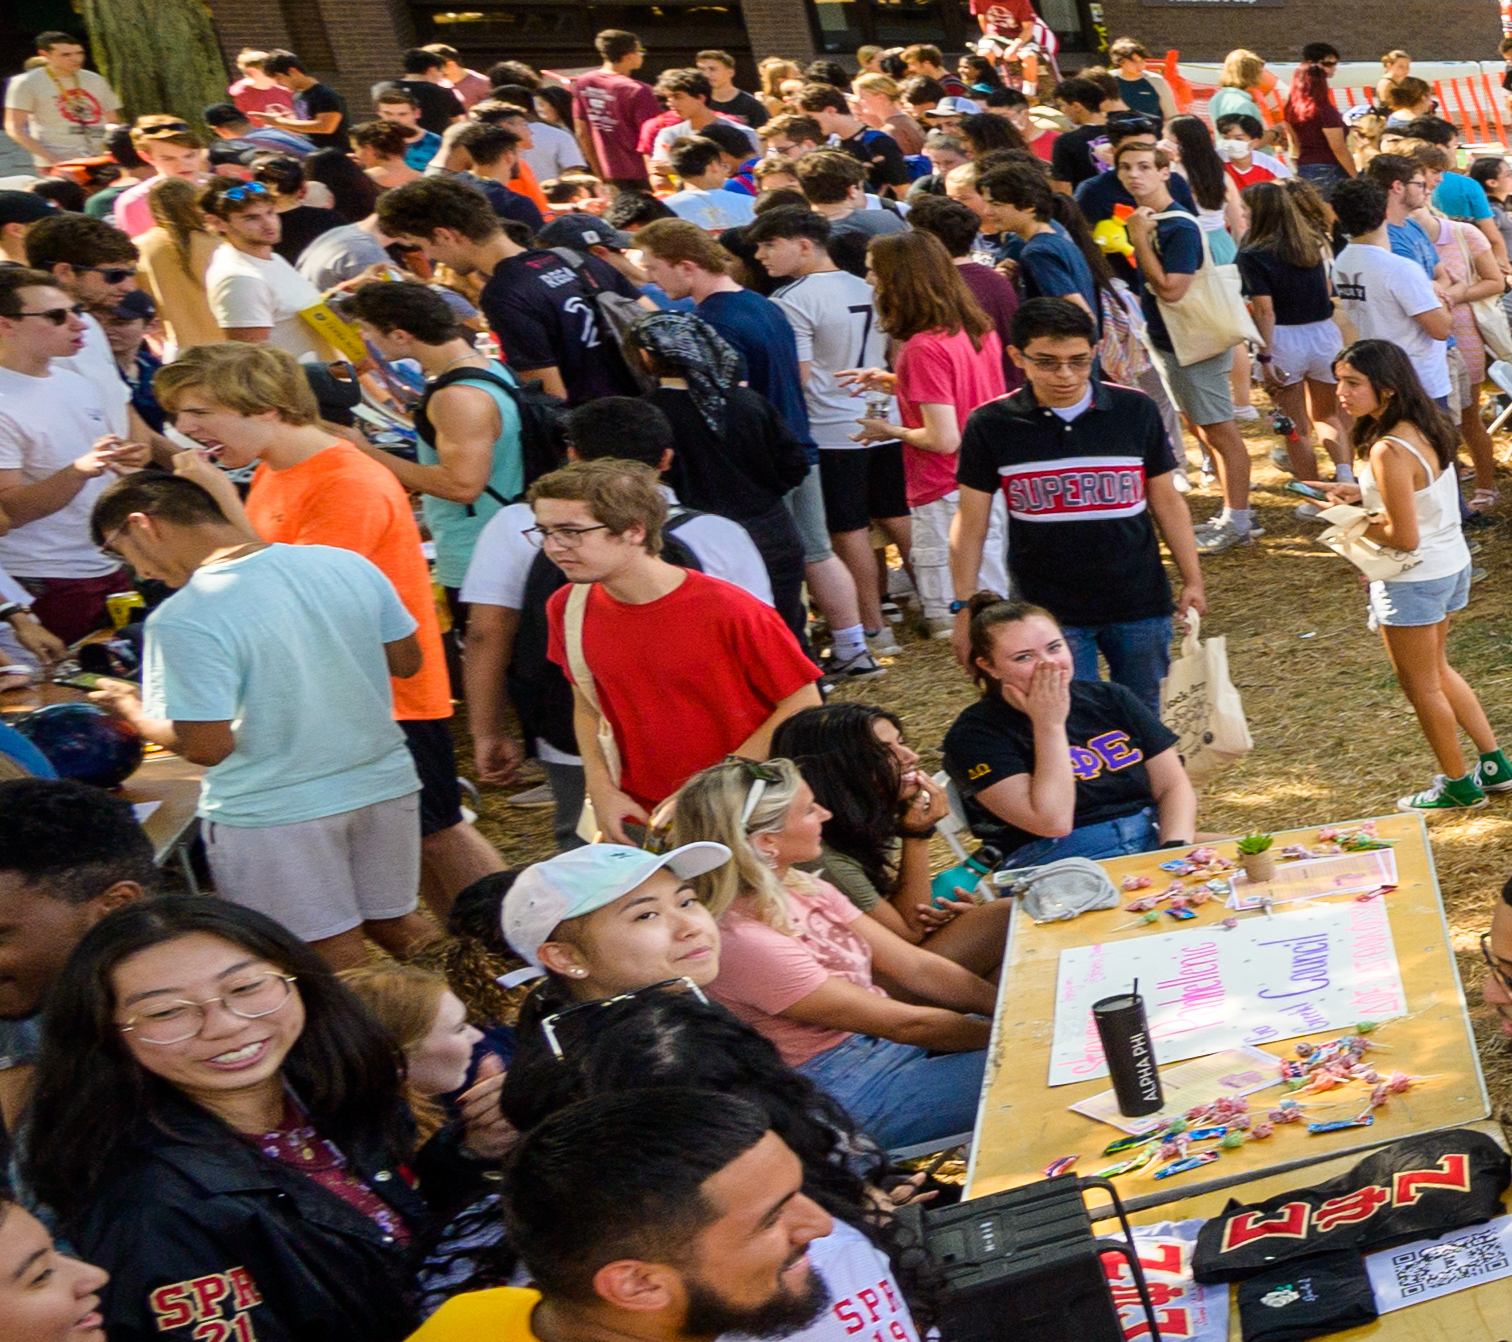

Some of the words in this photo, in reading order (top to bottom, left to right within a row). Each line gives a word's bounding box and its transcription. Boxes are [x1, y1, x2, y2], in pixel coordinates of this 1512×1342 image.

[1257, 932, 1330, 1000] Council
[1130, 1033, 1151, 1058] PHI
[1134, 1056, 1159, 1102] ALPHA
[149, 1264, 264, 1333] SPR
